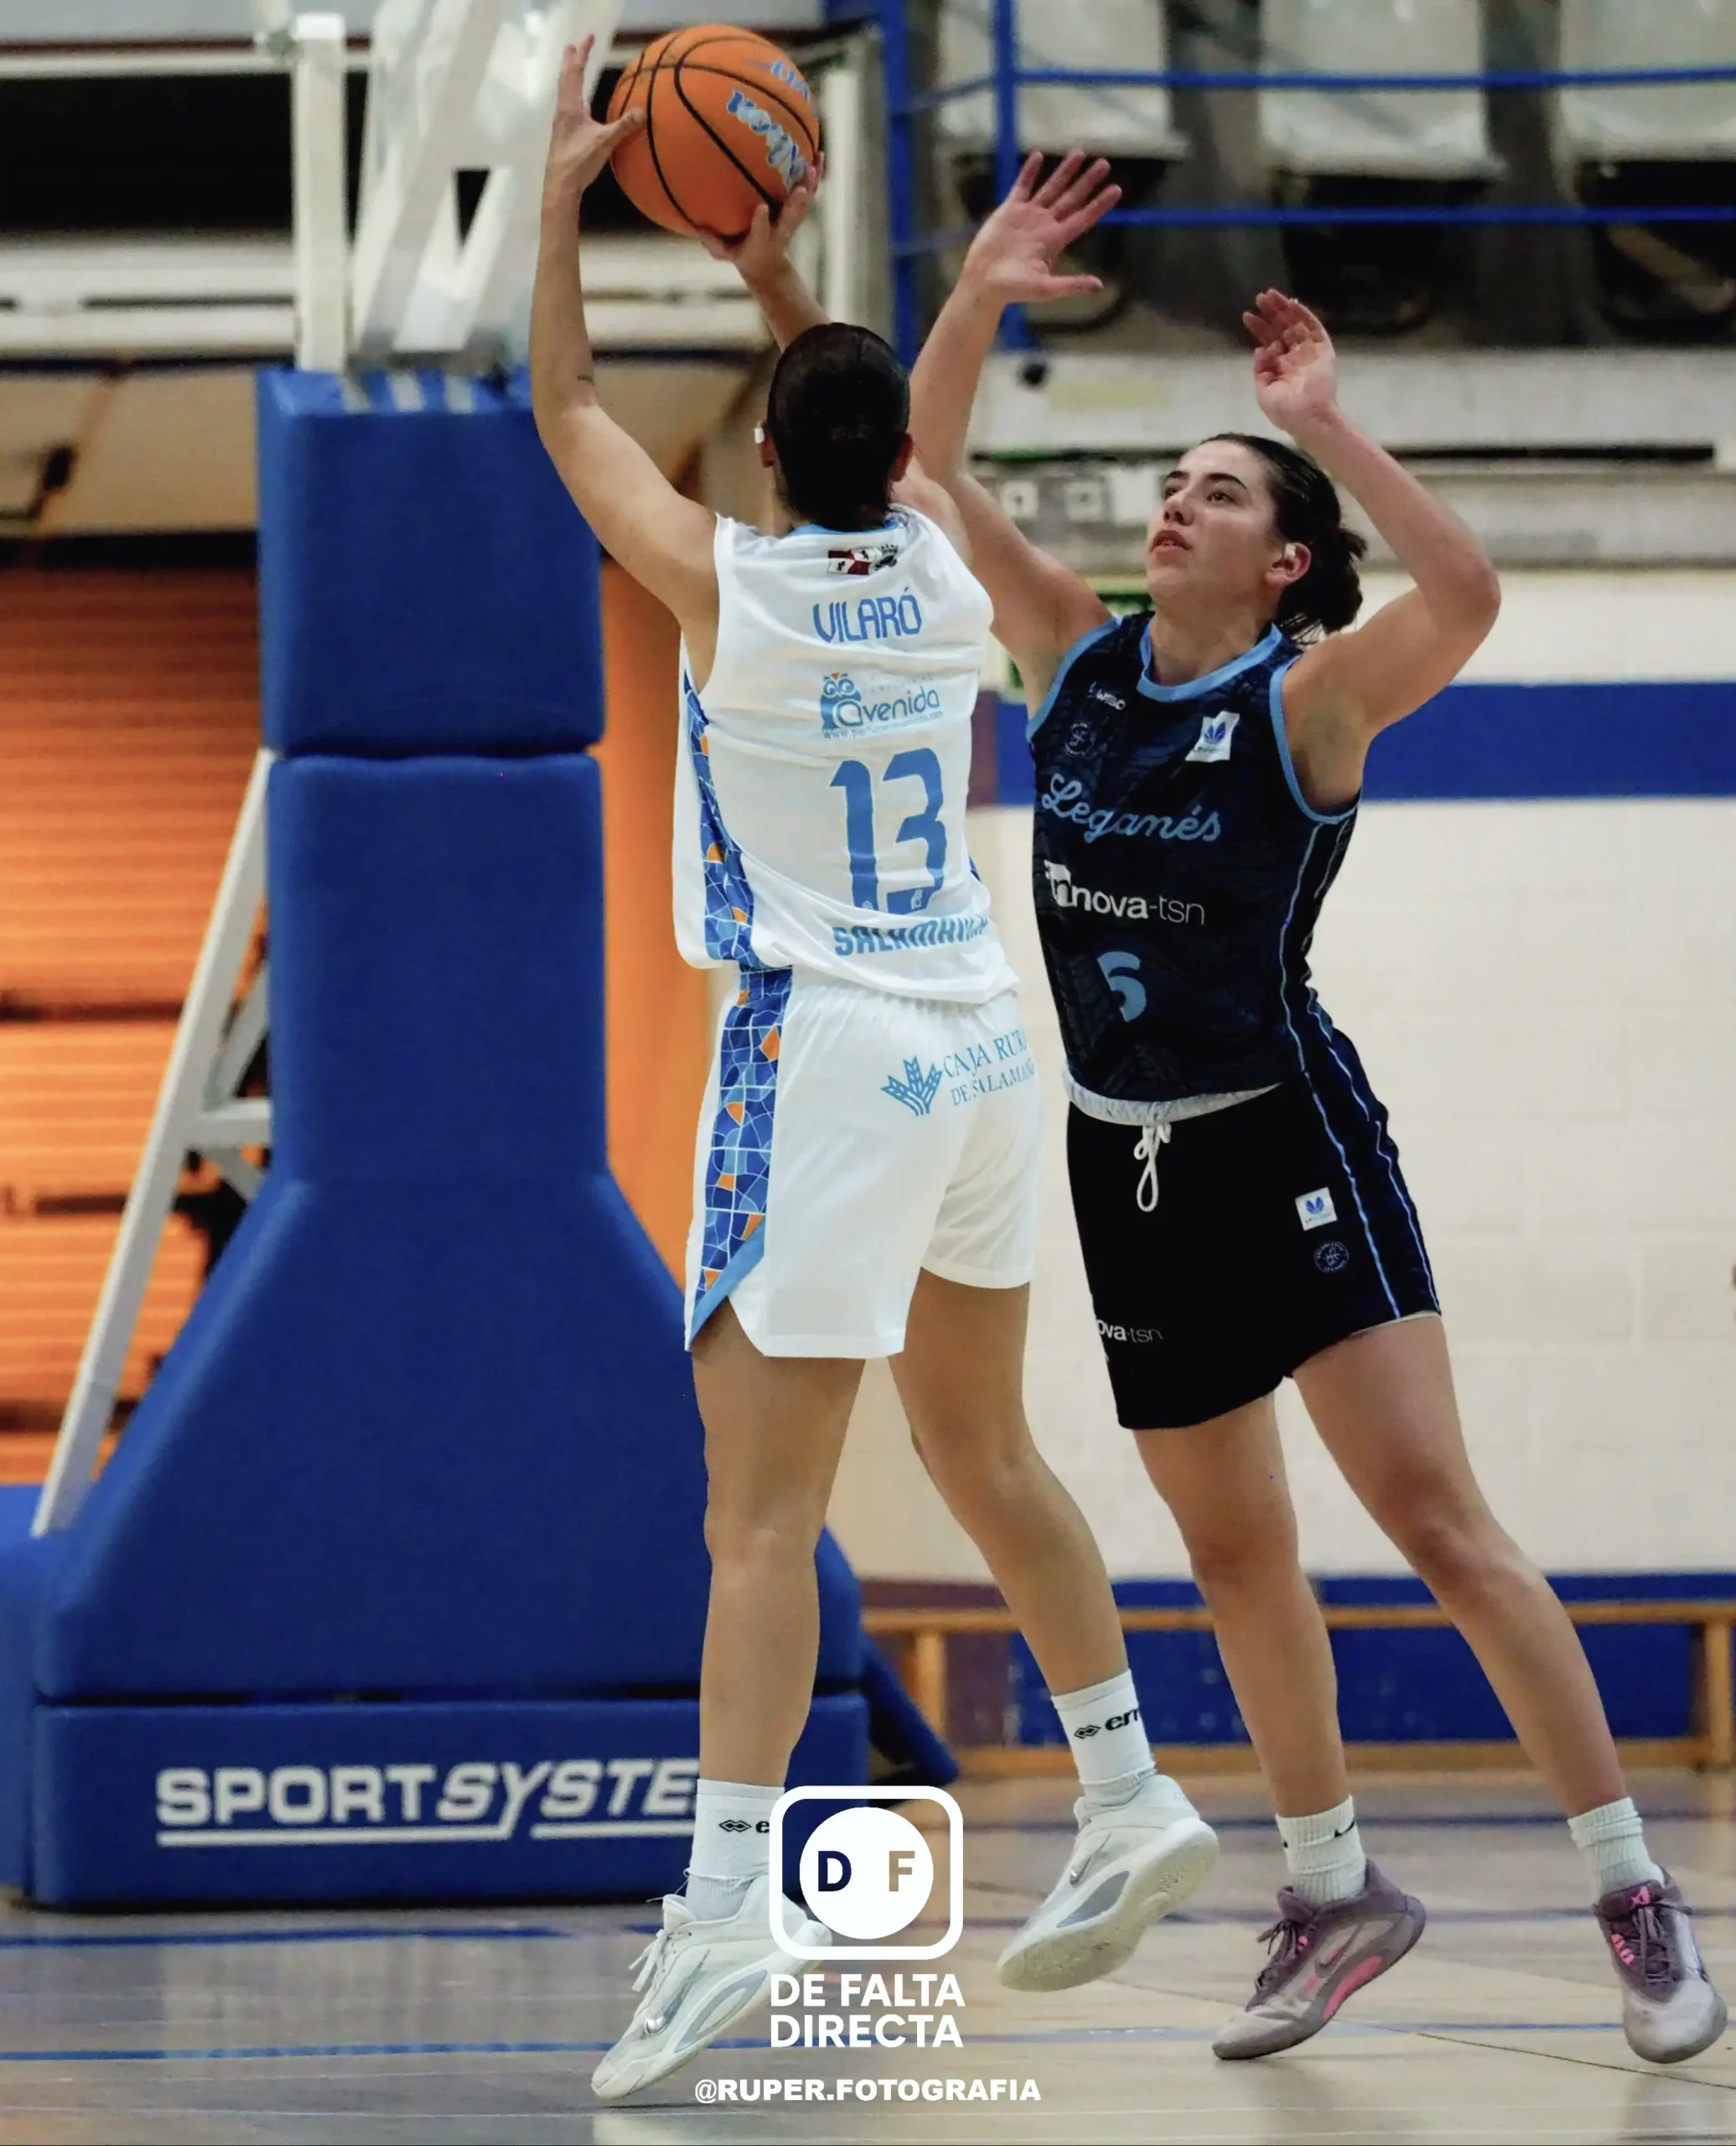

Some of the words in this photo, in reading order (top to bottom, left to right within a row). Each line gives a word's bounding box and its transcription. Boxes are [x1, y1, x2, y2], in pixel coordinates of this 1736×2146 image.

[812, 586, 922, 643] VILARÓ
[837, 677, 940, 727] avenida
[829, 748, 947, 915] 13
[1041, 773, 1220, 844] Leganés
[1096, 951, 1147, 1023] 5
[943, 1044, 992, 1077] CAJA
[951, 1084, 972, 1106] DE
[157, 1759, 701, 1838] SPORTSYSTE
